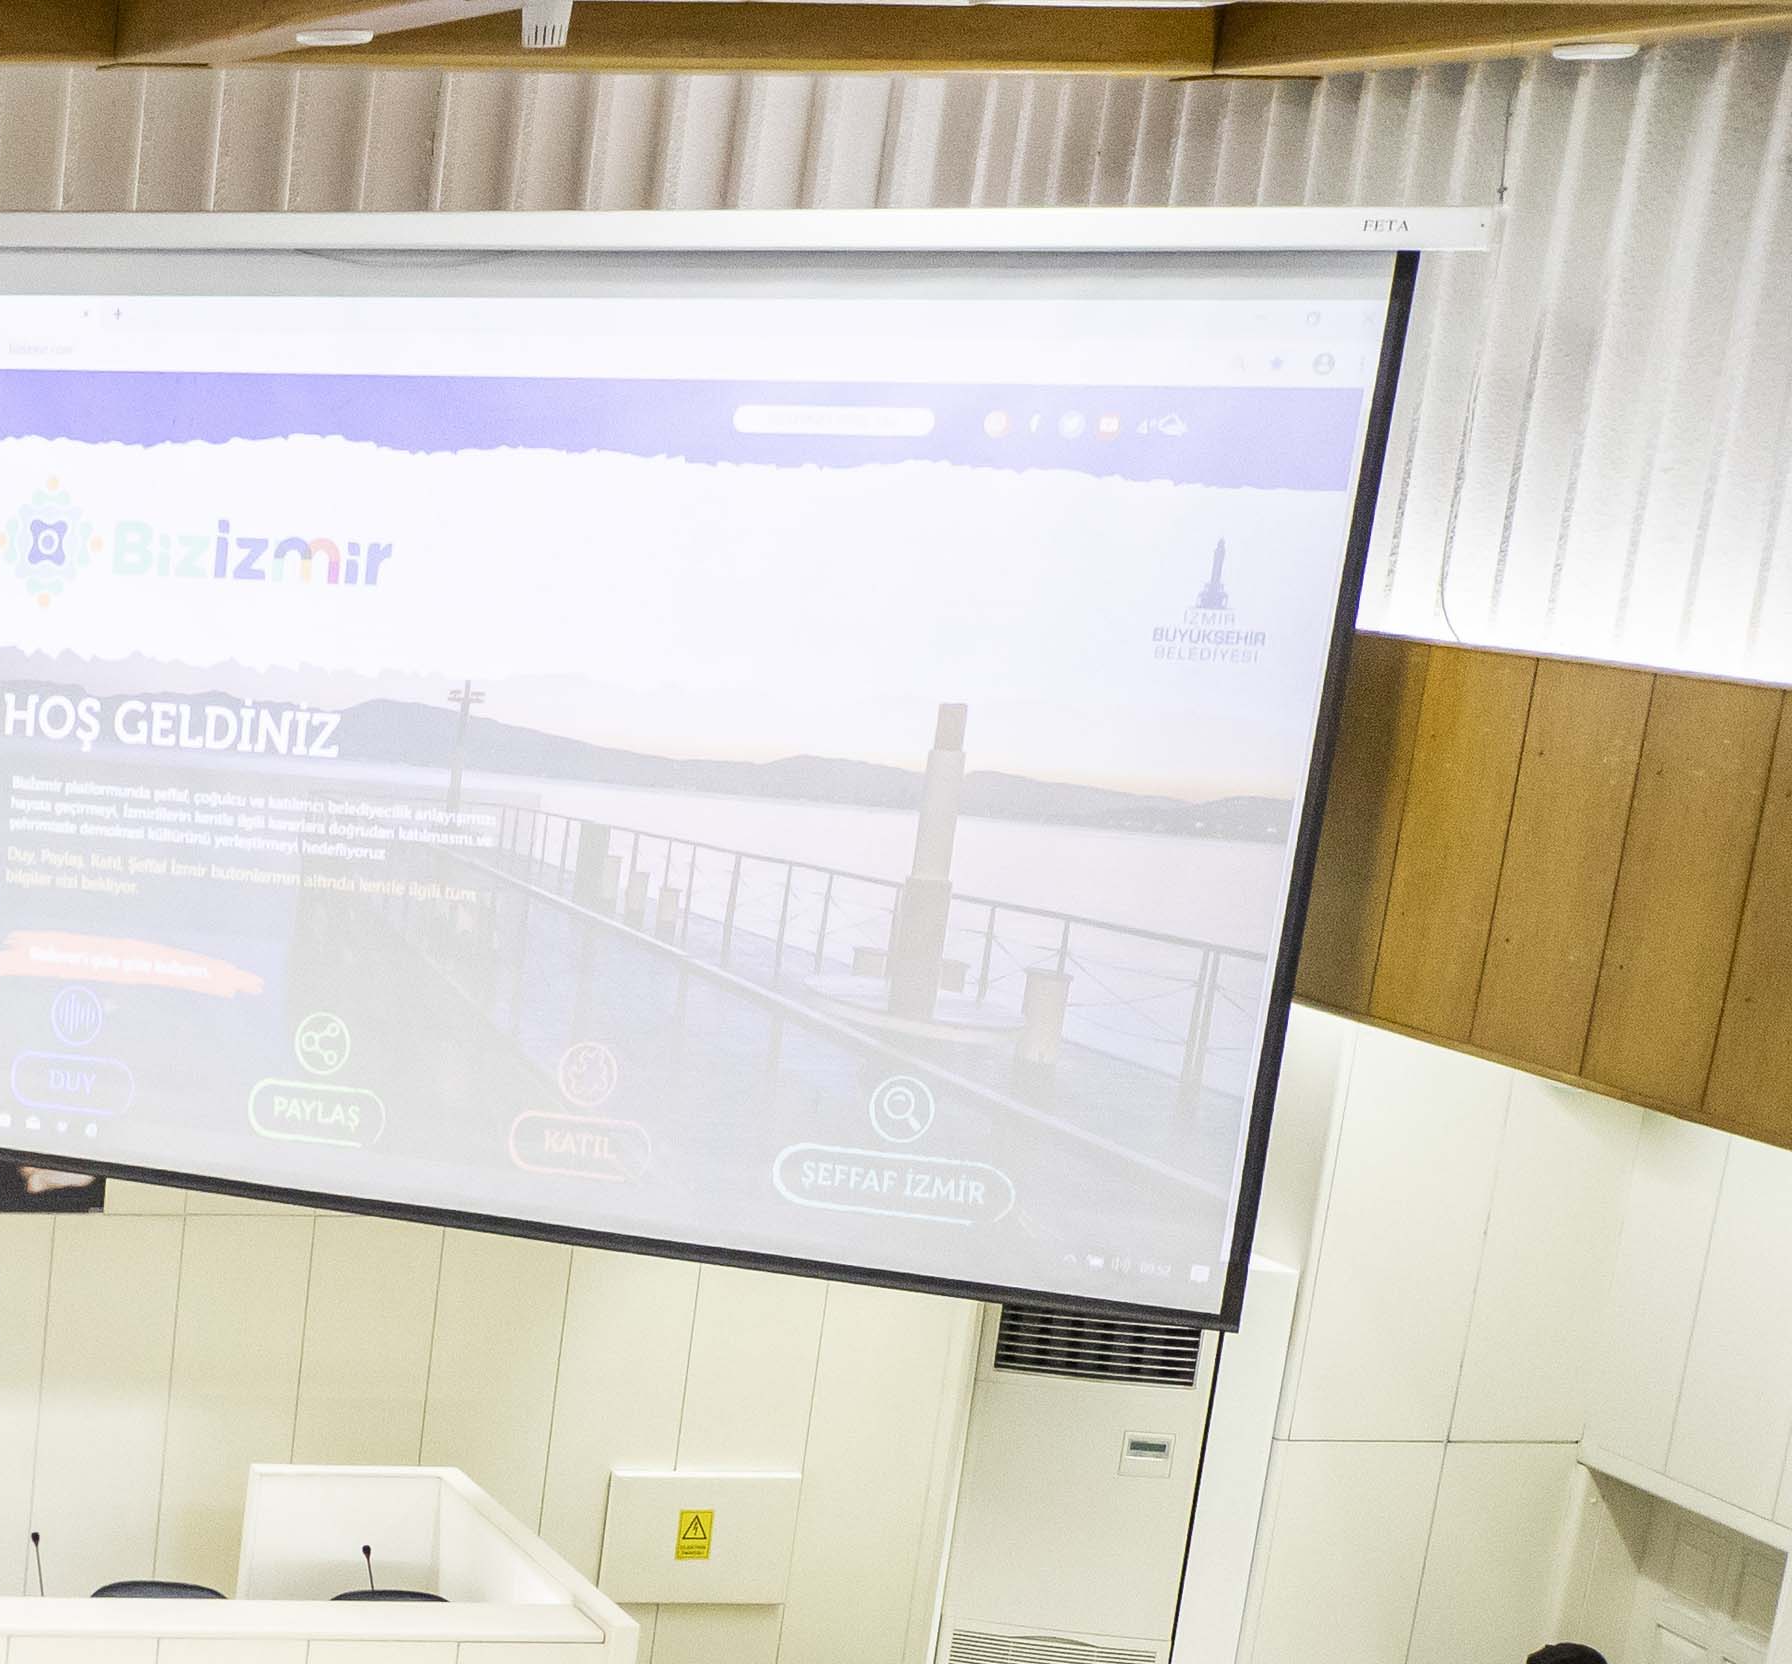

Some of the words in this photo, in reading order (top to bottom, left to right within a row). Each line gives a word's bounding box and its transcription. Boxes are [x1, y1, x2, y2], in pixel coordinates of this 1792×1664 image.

[112, 518, 394, 587] Bizizmir
[4, 692, 101, 752] HOŞ
[113, 697, 341, 758] GELDİNİZ
[48, 1068, 97, 1096] DUY
[273, 1093, 362, 1130] PAYLAŞ
[543, 1128, 616, 1161] KATIL
[801, 1160, 897, 1196] ŞEFFAF
[903, 1166, 986, 1206] İZMİR
